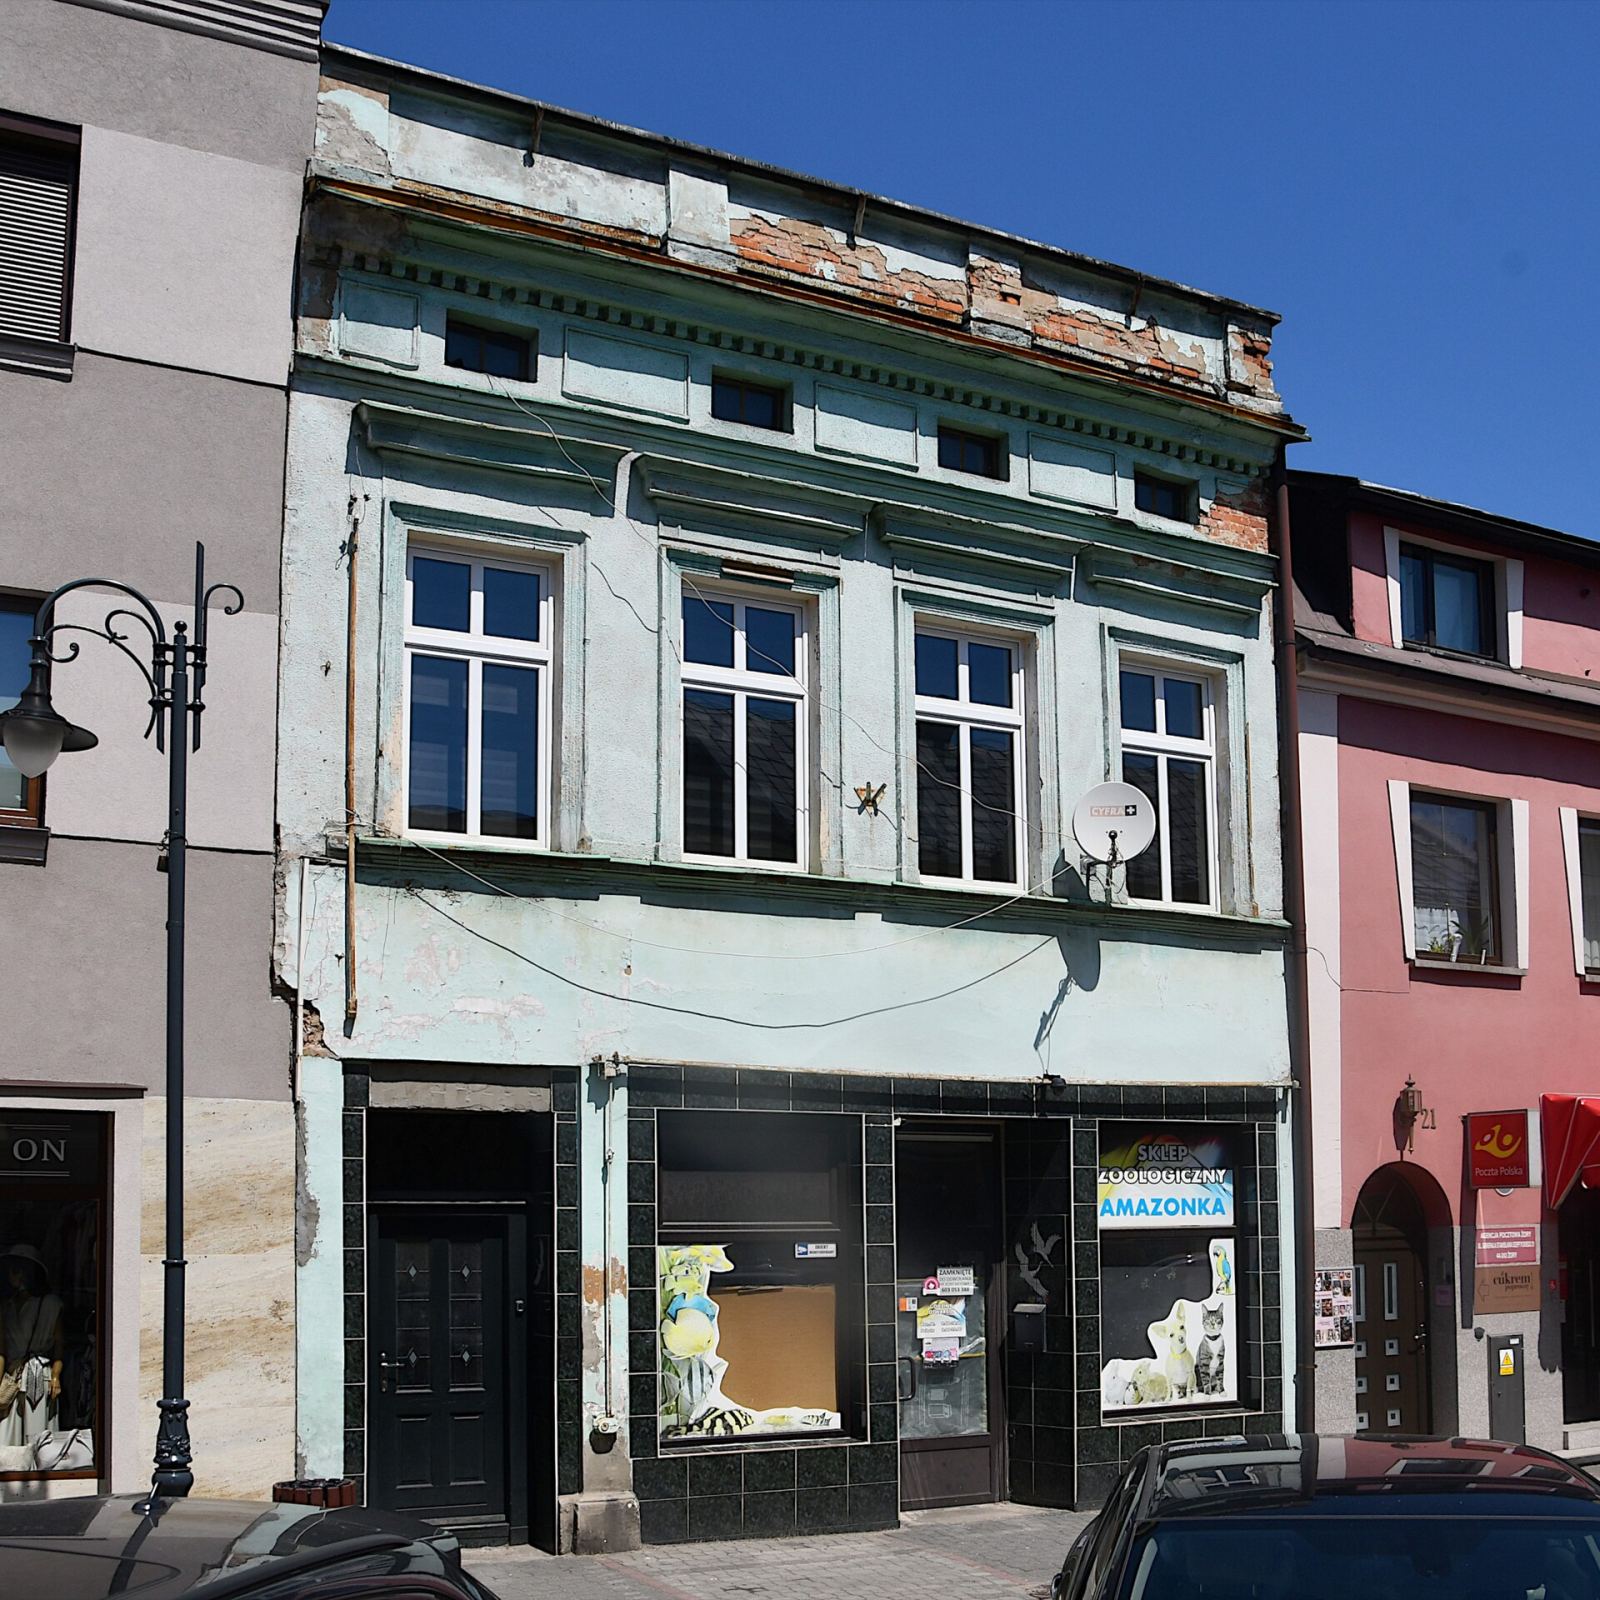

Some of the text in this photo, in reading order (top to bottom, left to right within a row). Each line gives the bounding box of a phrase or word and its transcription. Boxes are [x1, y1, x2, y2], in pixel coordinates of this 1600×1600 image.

[1421, 1108, 1436, 1130] 21
[1137, 1144, 1189, 1162] SKLEP
[1098, 1167, 1227, 1185] ZOOLOGICZNY
[1475, 1166, 1523, 1176] Poczta Polska
[1100, 1198, 1226, 1217] AMAZONKA
